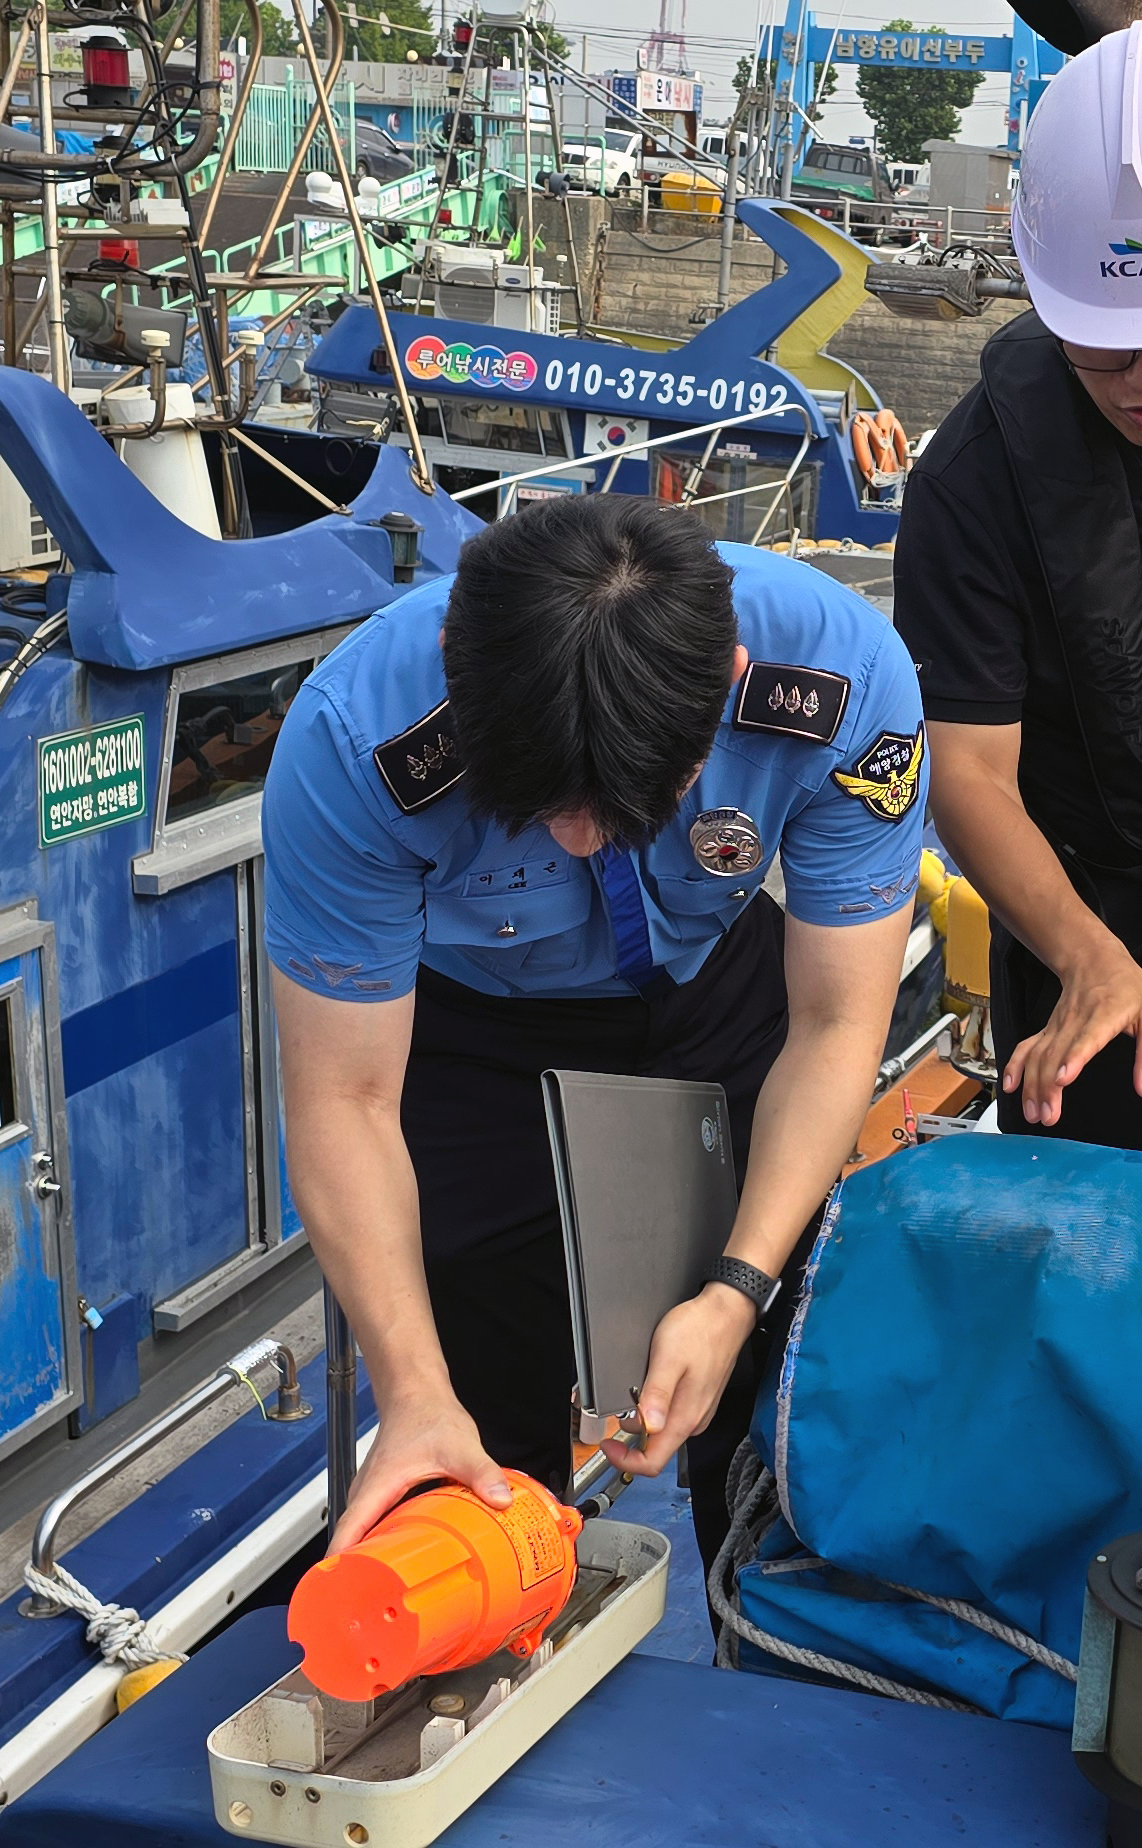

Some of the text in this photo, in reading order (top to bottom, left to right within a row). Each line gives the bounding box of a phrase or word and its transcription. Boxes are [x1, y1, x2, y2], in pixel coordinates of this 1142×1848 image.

[836, 33, 985, 64] 남항유어선부두
[415, 349, 530, 381] 루어낚시전문
[545, 359, 788, 417] 010-3735-0192
[44, 728, 140, 794] 1601002-6281100
[868, 746, 910, 776] 해양경찰
